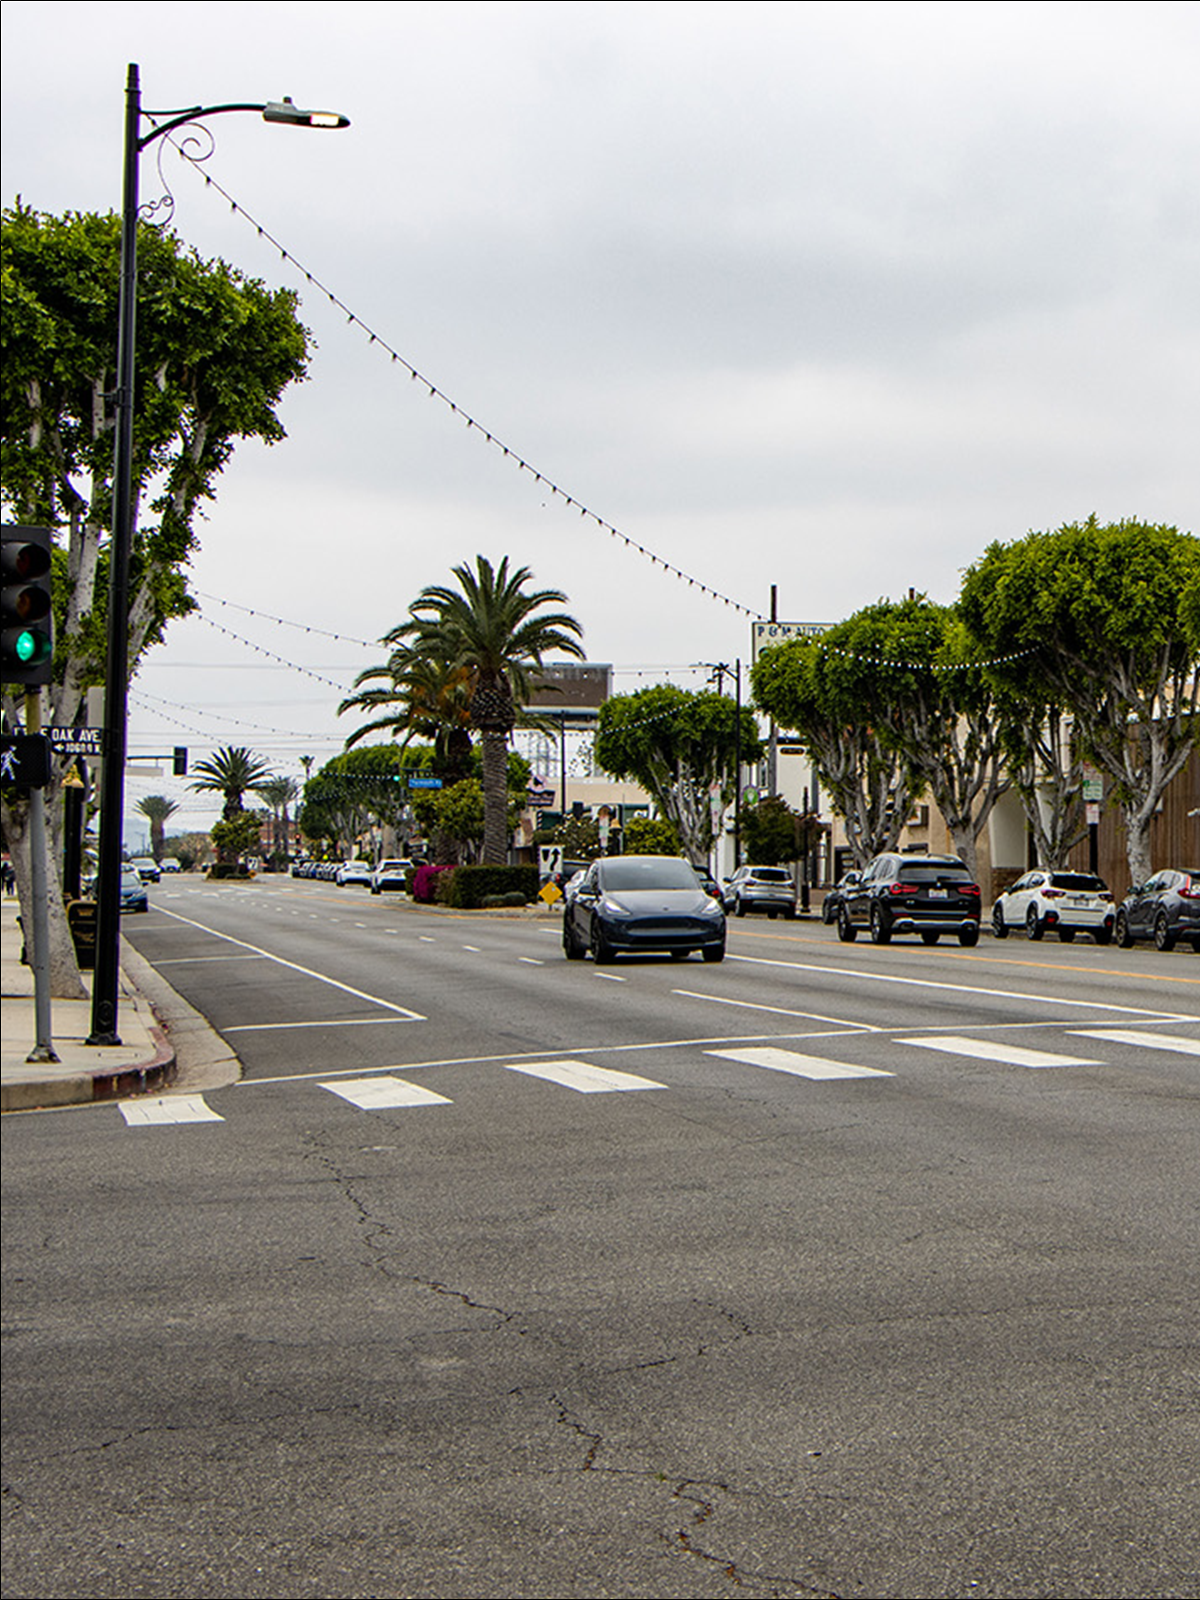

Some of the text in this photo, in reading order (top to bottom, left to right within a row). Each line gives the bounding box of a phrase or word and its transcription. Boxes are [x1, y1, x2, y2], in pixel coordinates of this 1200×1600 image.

[757, 626, 765, 637] P
[768, 626, 778, 637] &
[51, 727, 75, 742] OAK
[78, 728, 102, 743] AVE
